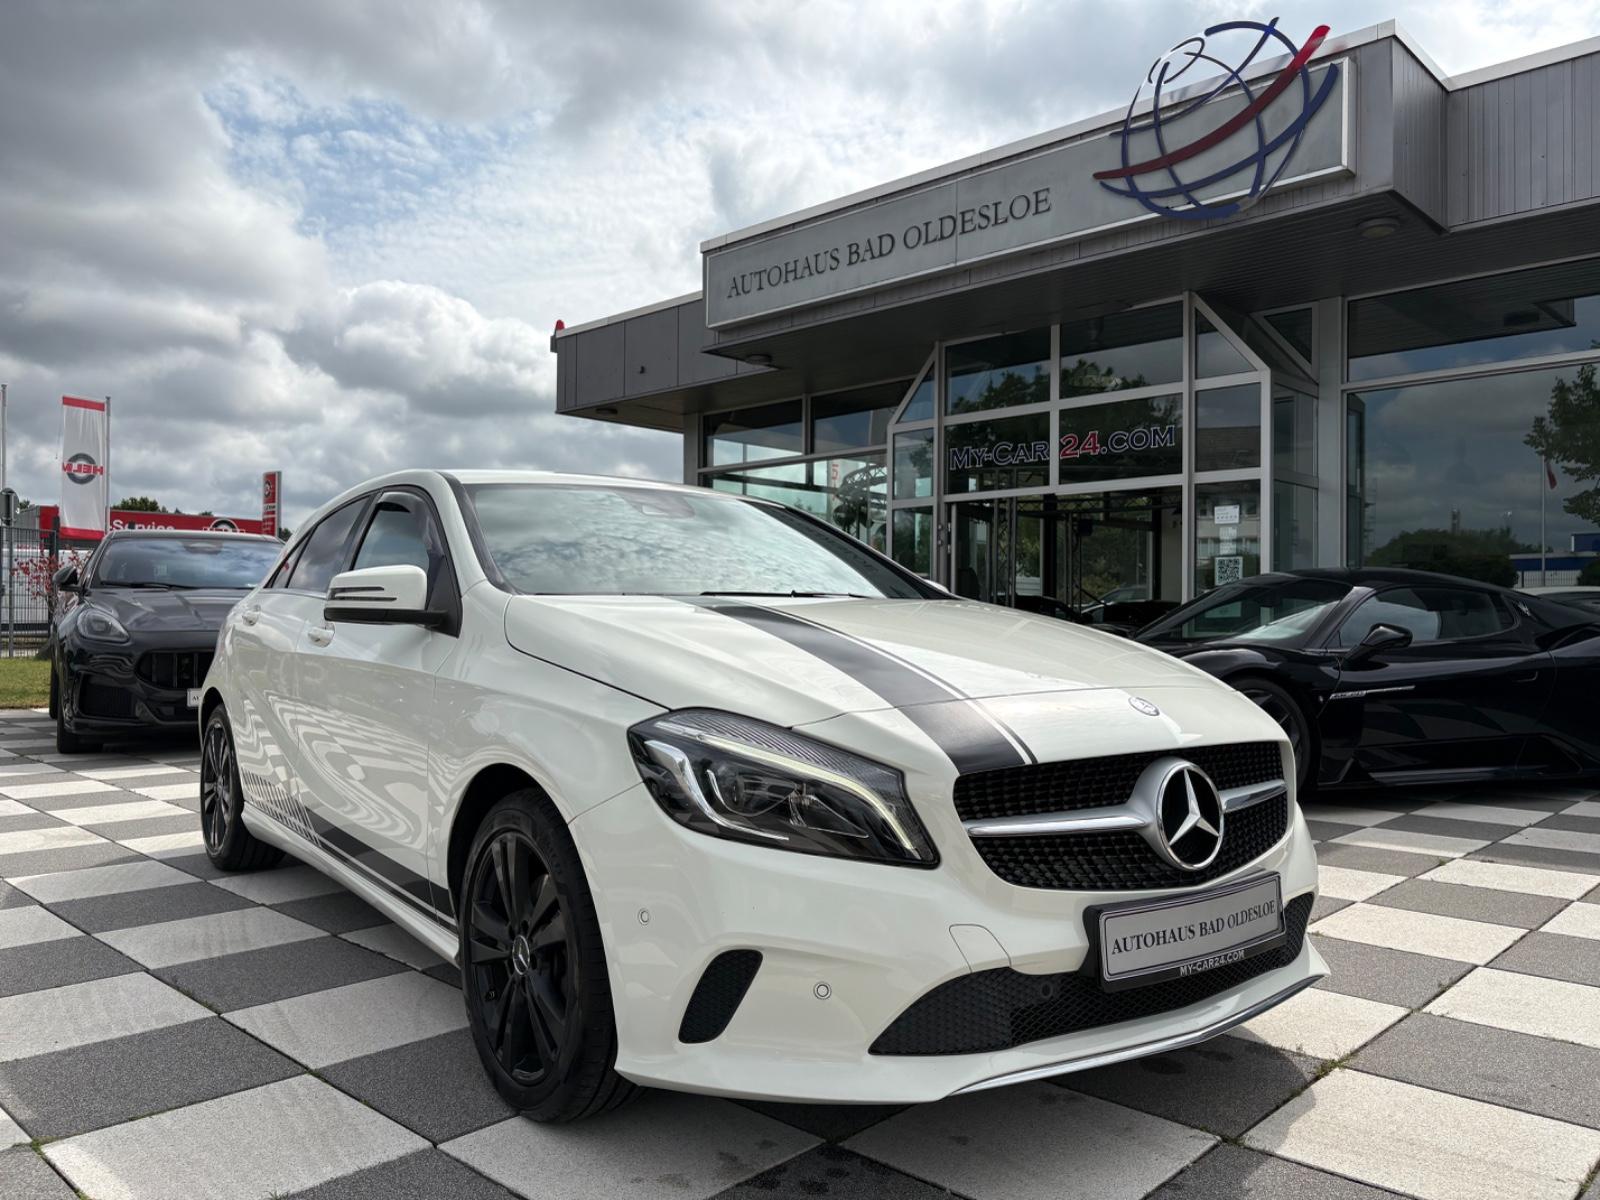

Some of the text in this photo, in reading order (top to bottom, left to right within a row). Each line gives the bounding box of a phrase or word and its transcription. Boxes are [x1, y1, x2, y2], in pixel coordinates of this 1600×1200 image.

[727, 187, 1052, 298] AUTOHAUS BAD OLDESLOE
[1111, 900, 1275, 954] AUTOHAUS BAD OLDESLOE
[1179, 949, 1245, 976] MY-CAR24.COM
